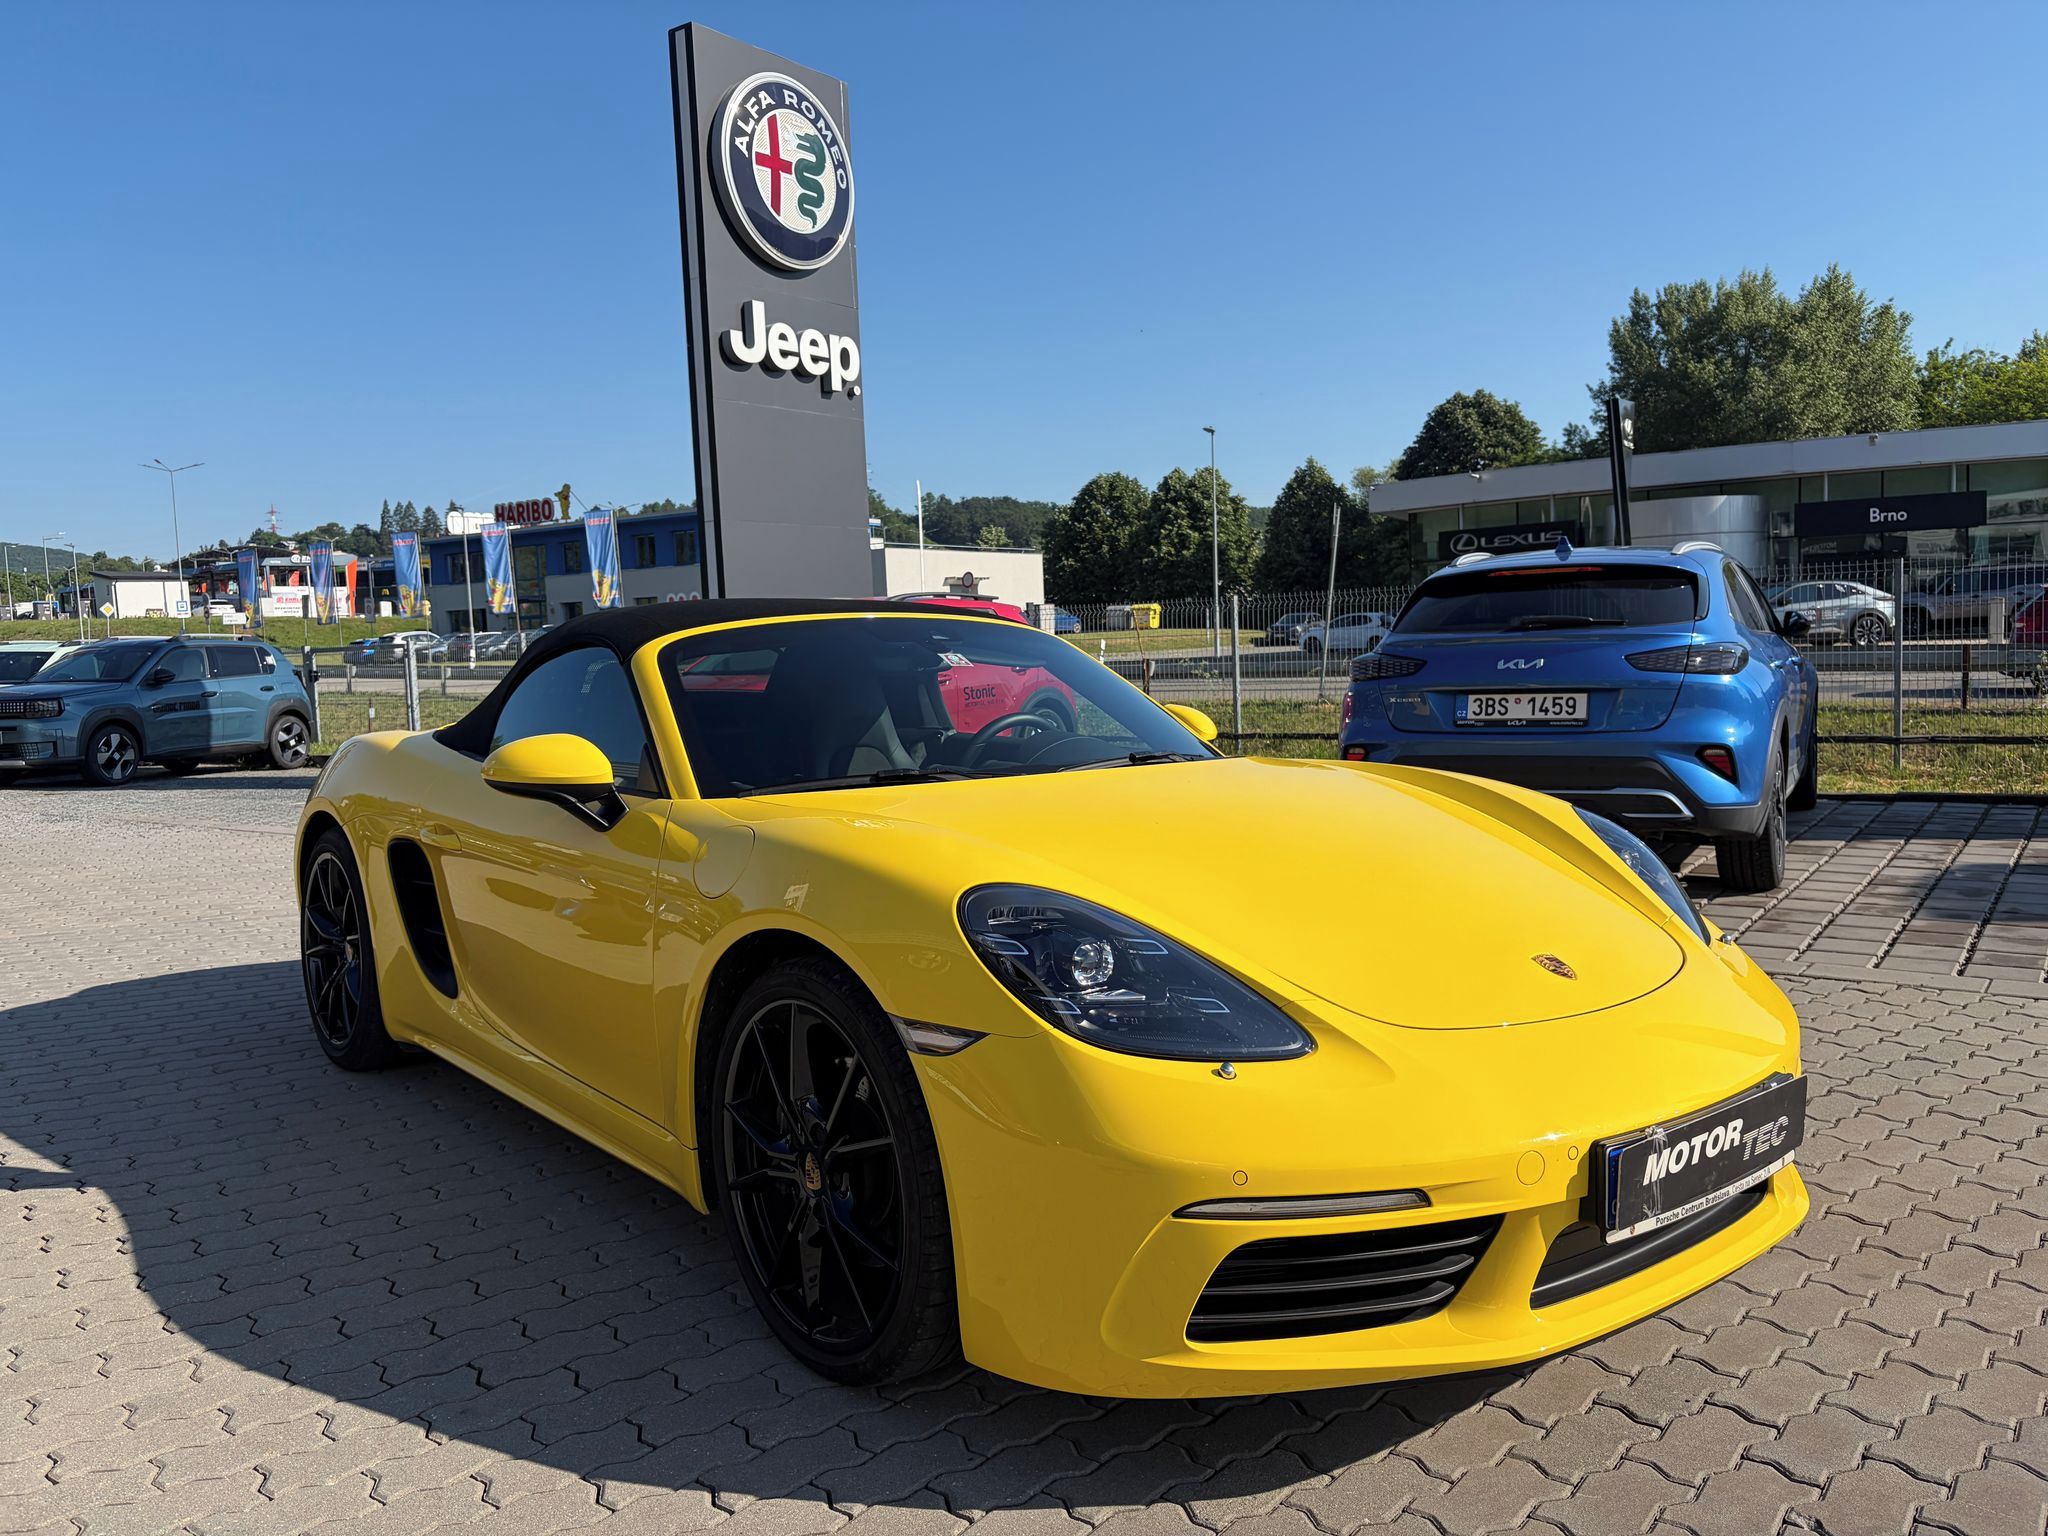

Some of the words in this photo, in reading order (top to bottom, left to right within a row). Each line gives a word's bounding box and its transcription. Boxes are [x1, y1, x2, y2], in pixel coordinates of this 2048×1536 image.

[734, 90, 776, 158] ALFA
[782, 89, 847, 190] ROMEO
[729, 299, 860, 392] Jeep
[494, 497, 556, 525] HARIBO
[1869, 507, 1908, 523] Brno
[1480, 530, 1563, 548] LEXUS
[1497, 658, 1544, 669] KIA
[963, 684, 996, 701] Stonic
[1471, 697, 1509, 717] 3BS
[1527, 696, 1577, 716] 1459
[1655, 1212, 1680, 1227] Porsche
[1680, 1200, 1704, 1216] Centrum
